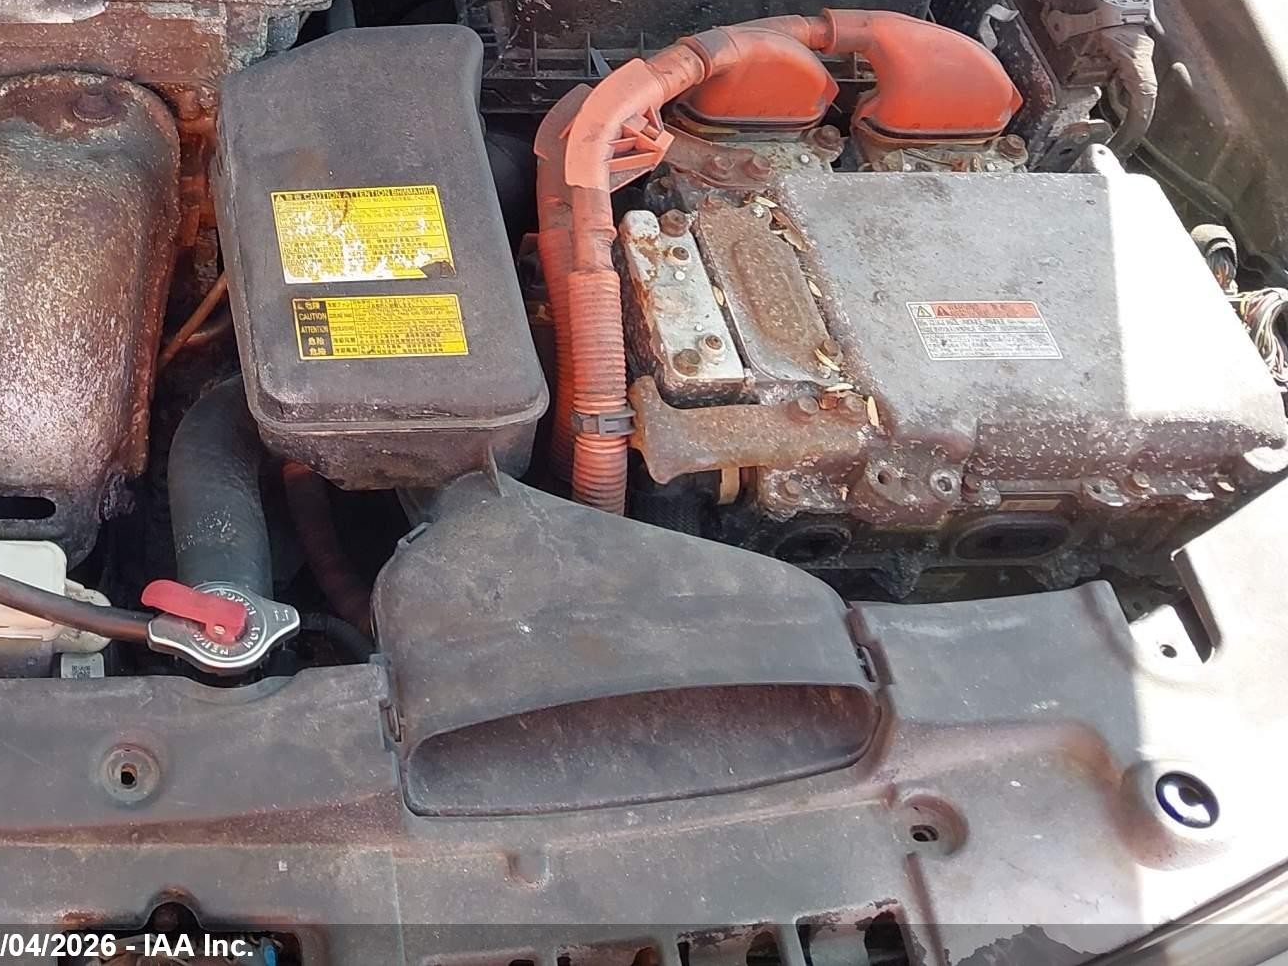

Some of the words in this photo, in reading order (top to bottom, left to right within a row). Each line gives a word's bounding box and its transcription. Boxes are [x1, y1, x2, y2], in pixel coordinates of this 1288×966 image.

[303, 191, 341, 200] CAUTION
[342, 189, 391, 199] ATTENTION
[298, 312, 327, 322] CAUTION
[300, 324, 329, 334] ATTENTION
